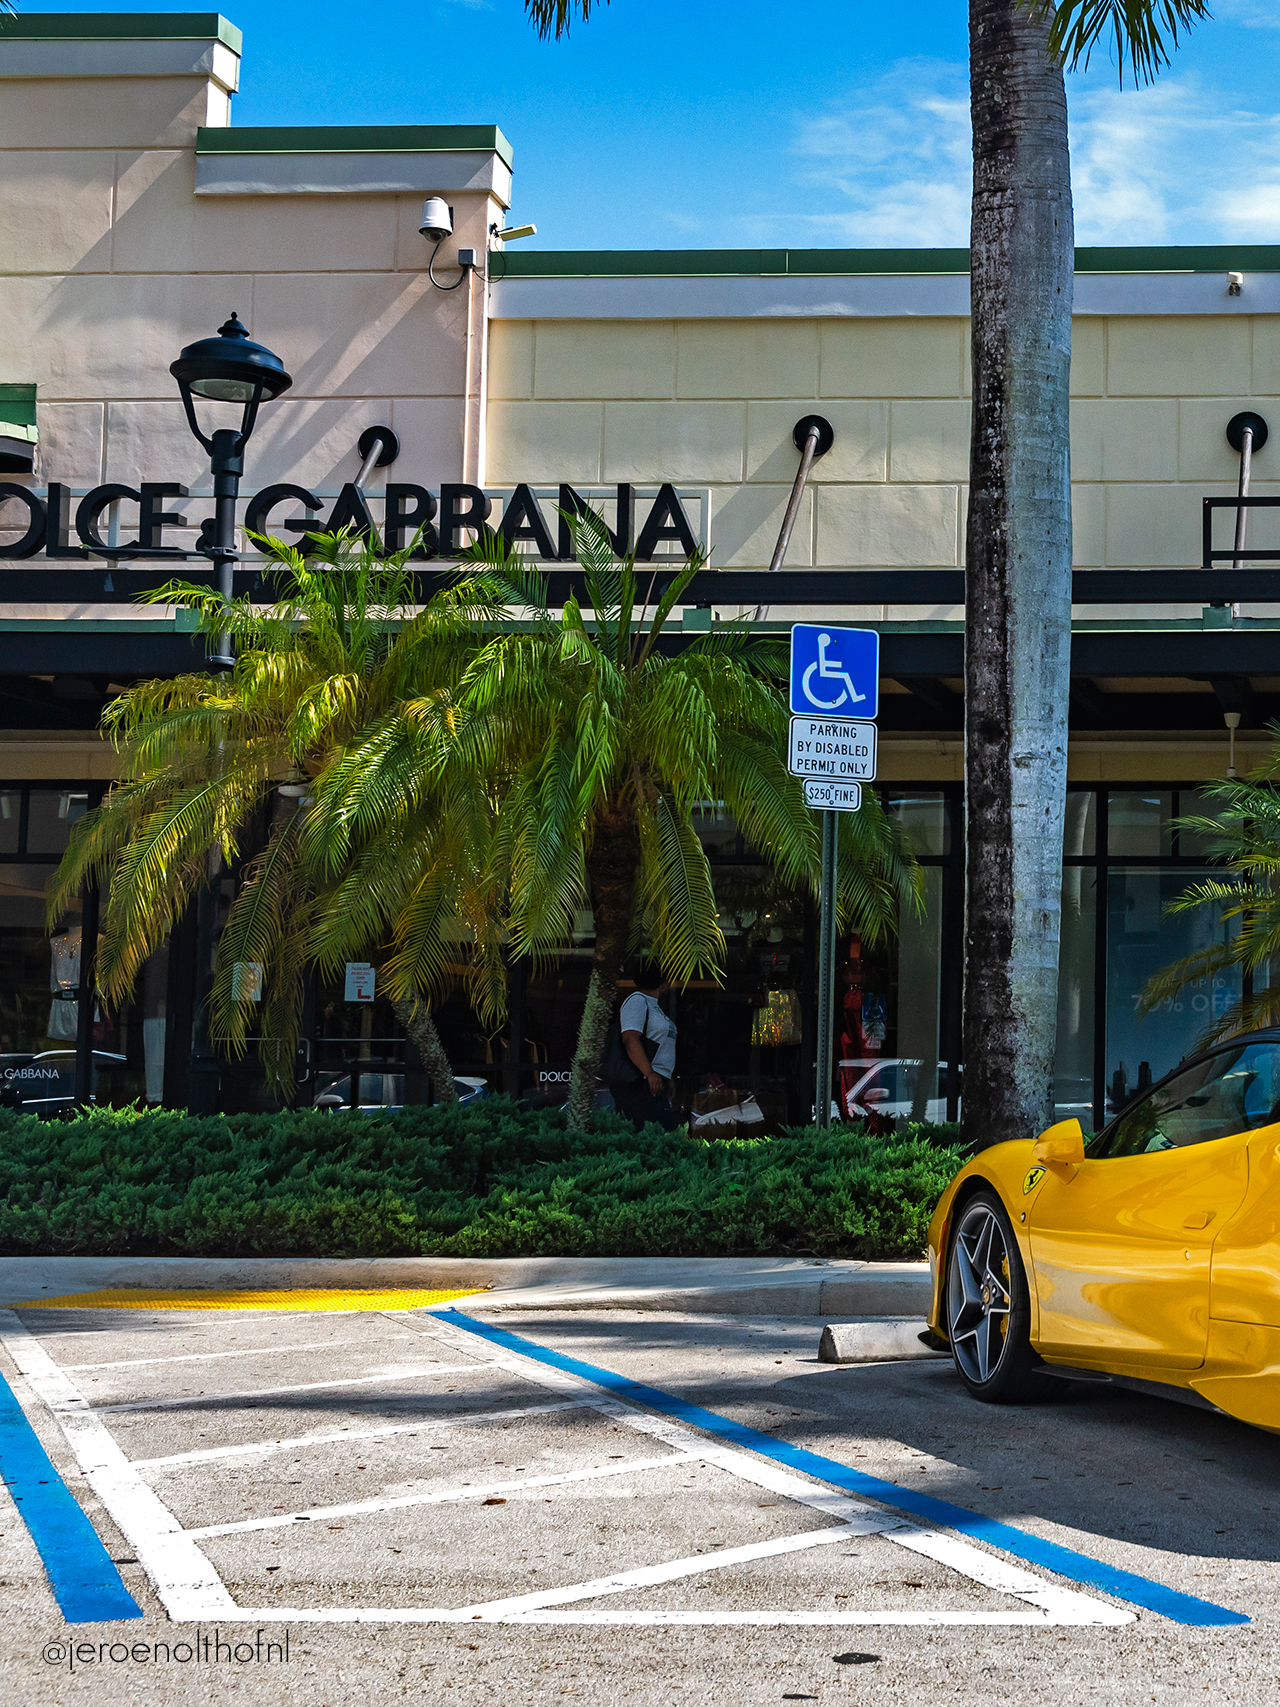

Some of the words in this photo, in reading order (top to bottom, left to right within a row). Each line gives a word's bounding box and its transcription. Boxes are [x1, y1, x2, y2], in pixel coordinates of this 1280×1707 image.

[244, 483, 702, 560] GABBANA
[809, 723, 858, 739] PARKING
[797, 740, 812, 753] BY
[815, 742, 868, 757] DISABLED
[797, 758, 836, 773] PERMIT
[839, 761, 868, 775] ONLY
[808, 786, 830, 801] $250
[834, 788, 855, 802] FINE
[4, 1068, 60, 1079] GABBANA
